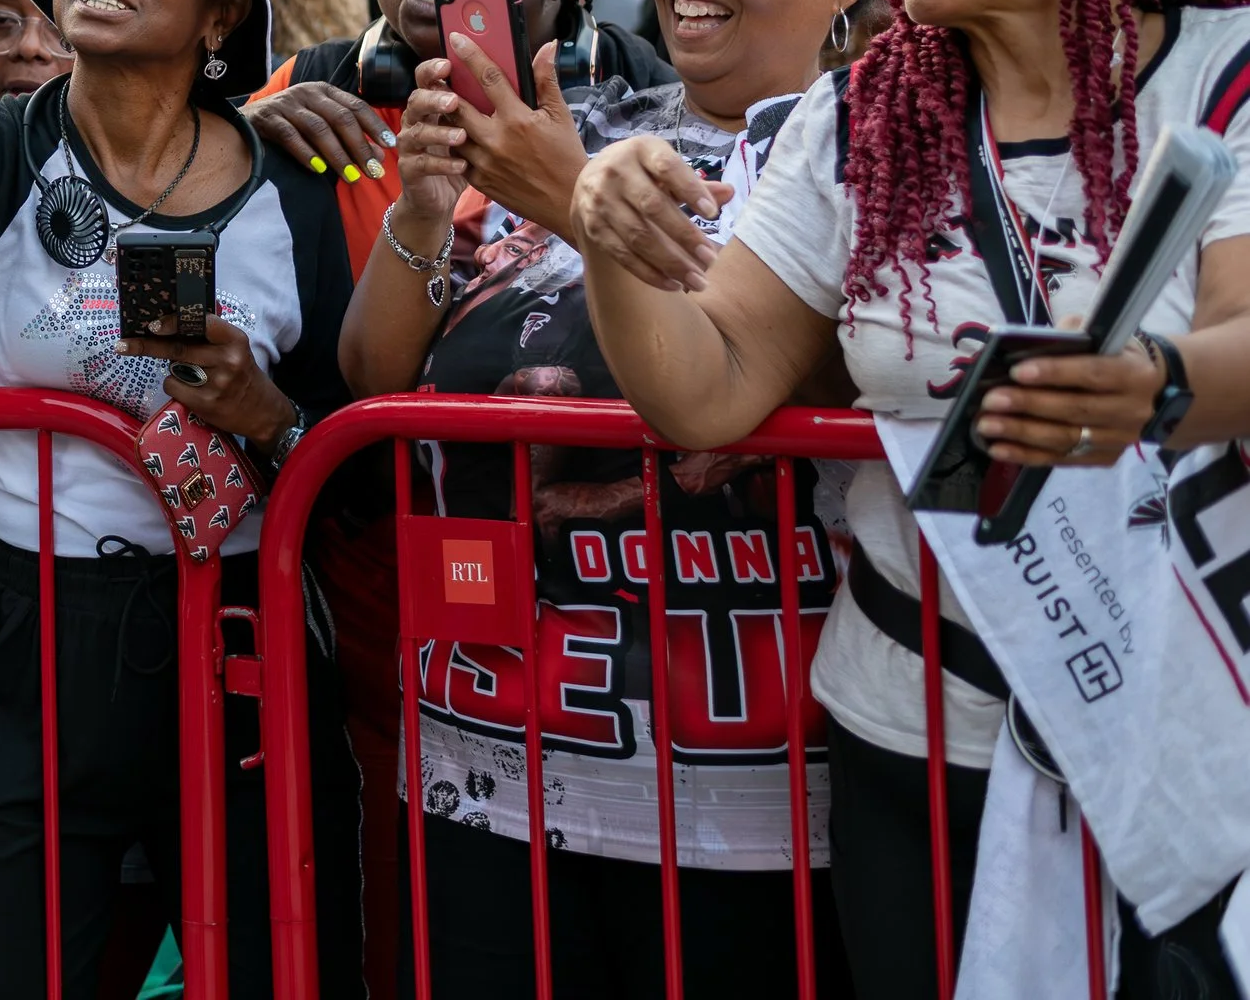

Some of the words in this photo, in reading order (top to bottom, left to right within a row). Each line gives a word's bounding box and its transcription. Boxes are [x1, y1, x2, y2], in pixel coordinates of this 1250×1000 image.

[451, 562, 489, 582] RTL
[570, 526, 825, 584] DONNA
[1005, 532, 1088, 640] RUIST
[1047, 496, 1126, 621] Presented
[1118, 620, 1136, 656] by
